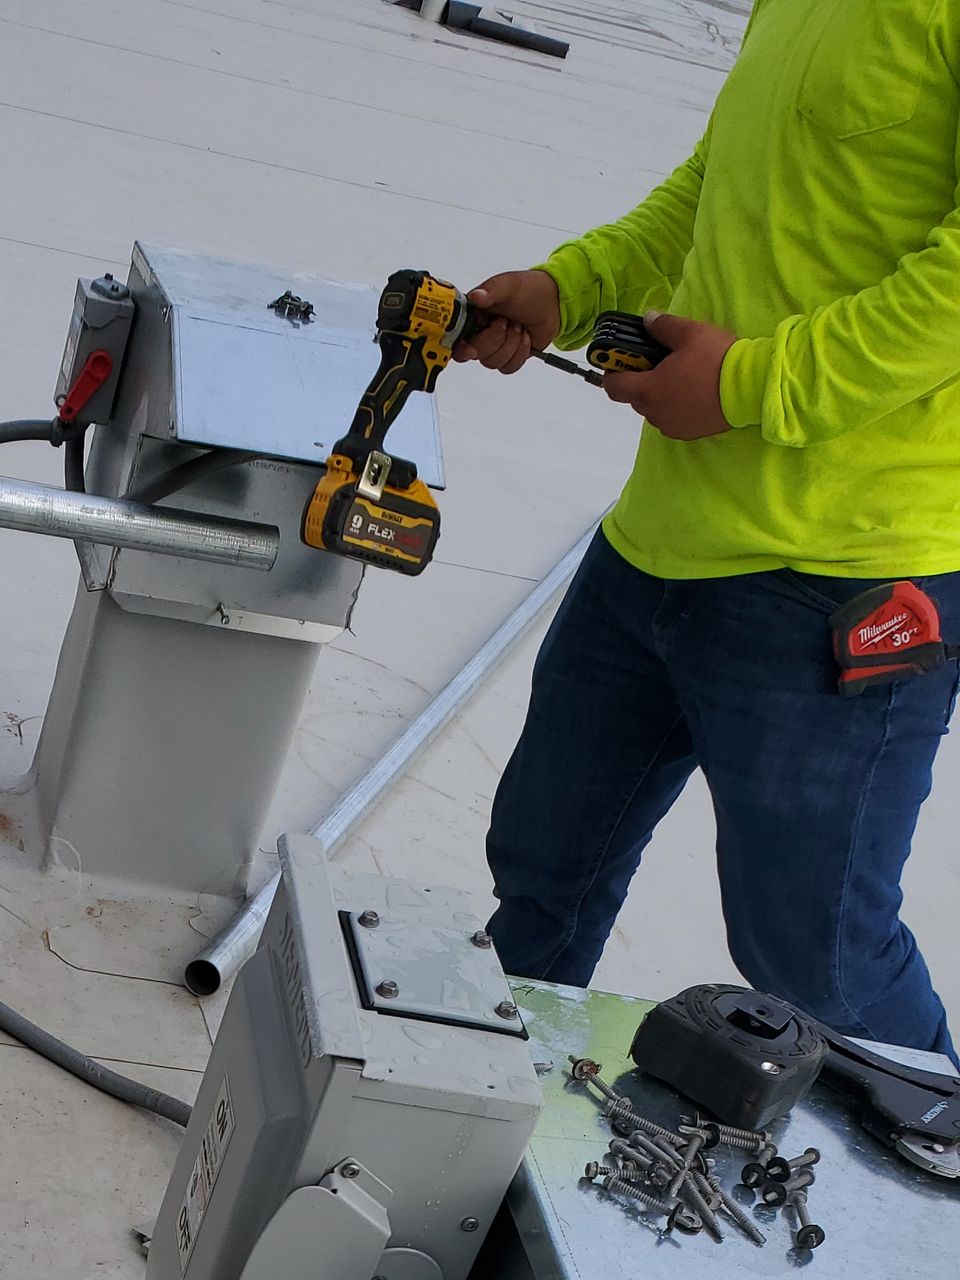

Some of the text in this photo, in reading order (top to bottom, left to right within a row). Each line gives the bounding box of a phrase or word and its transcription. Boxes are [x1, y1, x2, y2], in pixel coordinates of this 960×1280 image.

[351, 514, 363, 529] 9
[857, 612, 909, 644] Milwaukee
[179, 1206, 191, 1252] OFF
